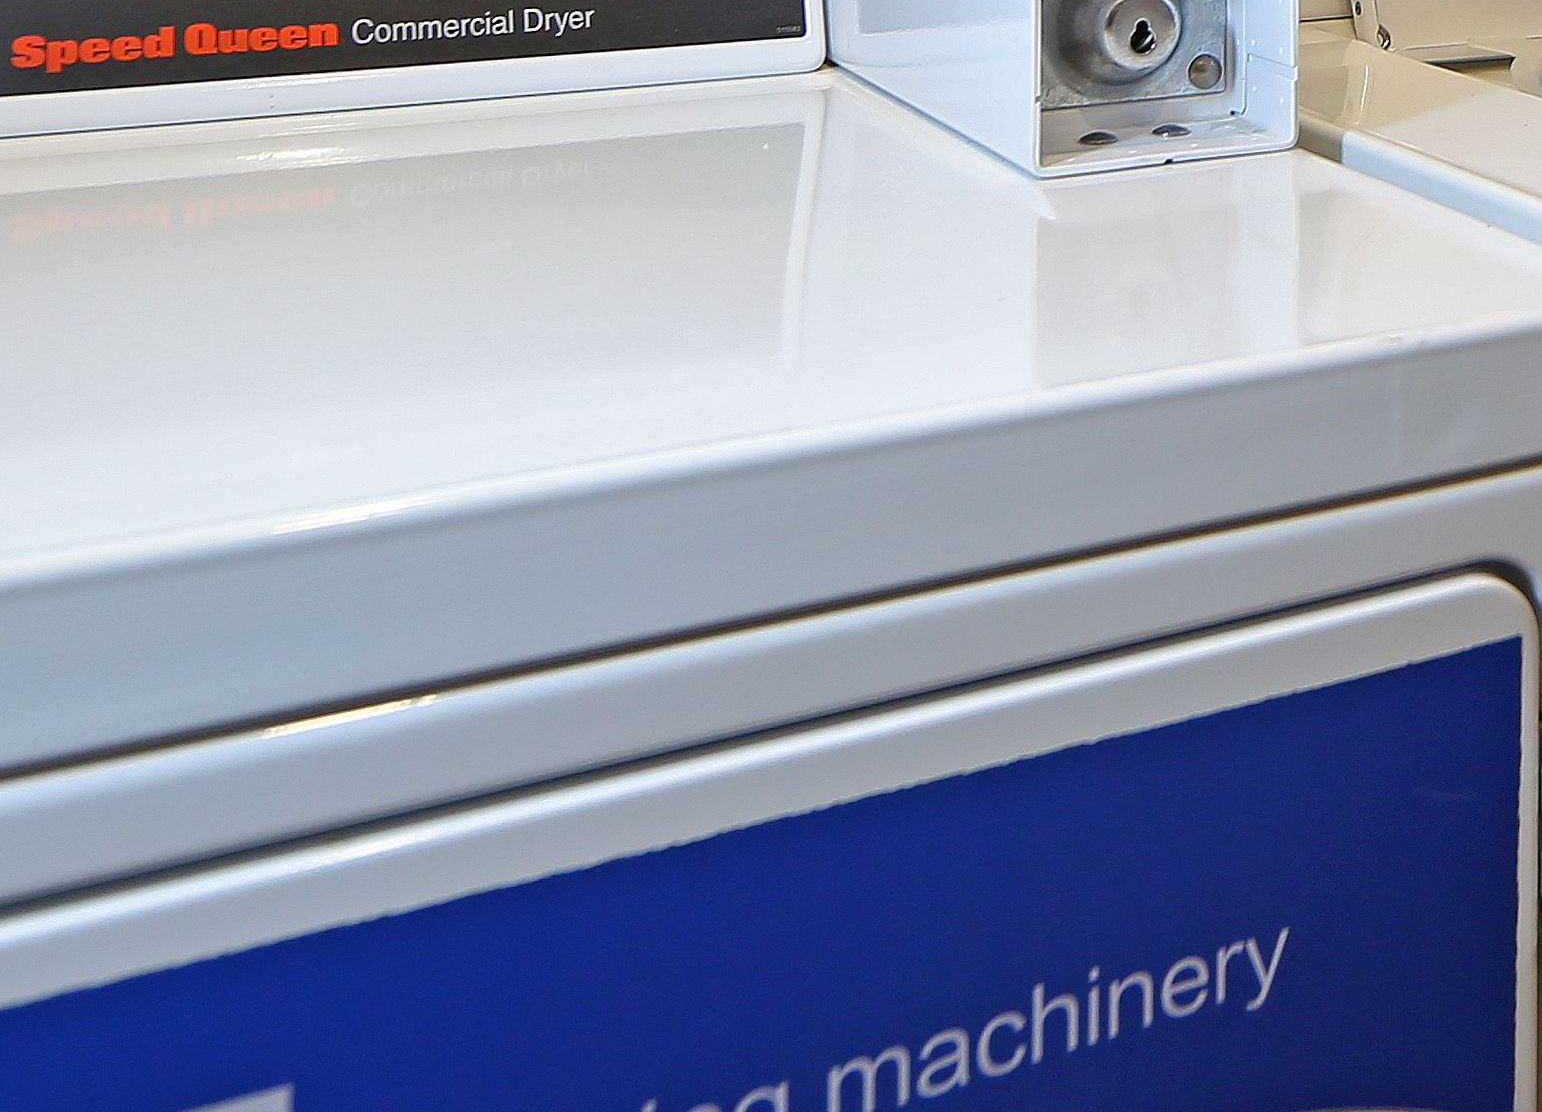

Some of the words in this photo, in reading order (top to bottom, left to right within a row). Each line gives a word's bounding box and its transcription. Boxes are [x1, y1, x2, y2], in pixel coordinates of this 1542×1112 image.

[11, 25, 177, 73] Speed
[183, 22, 341, 56] Queen
[351, 9, 514, 45] Commercial
[523, 8, 596, 37] Dryer
[828, 928, 1290, 1112] machinery
